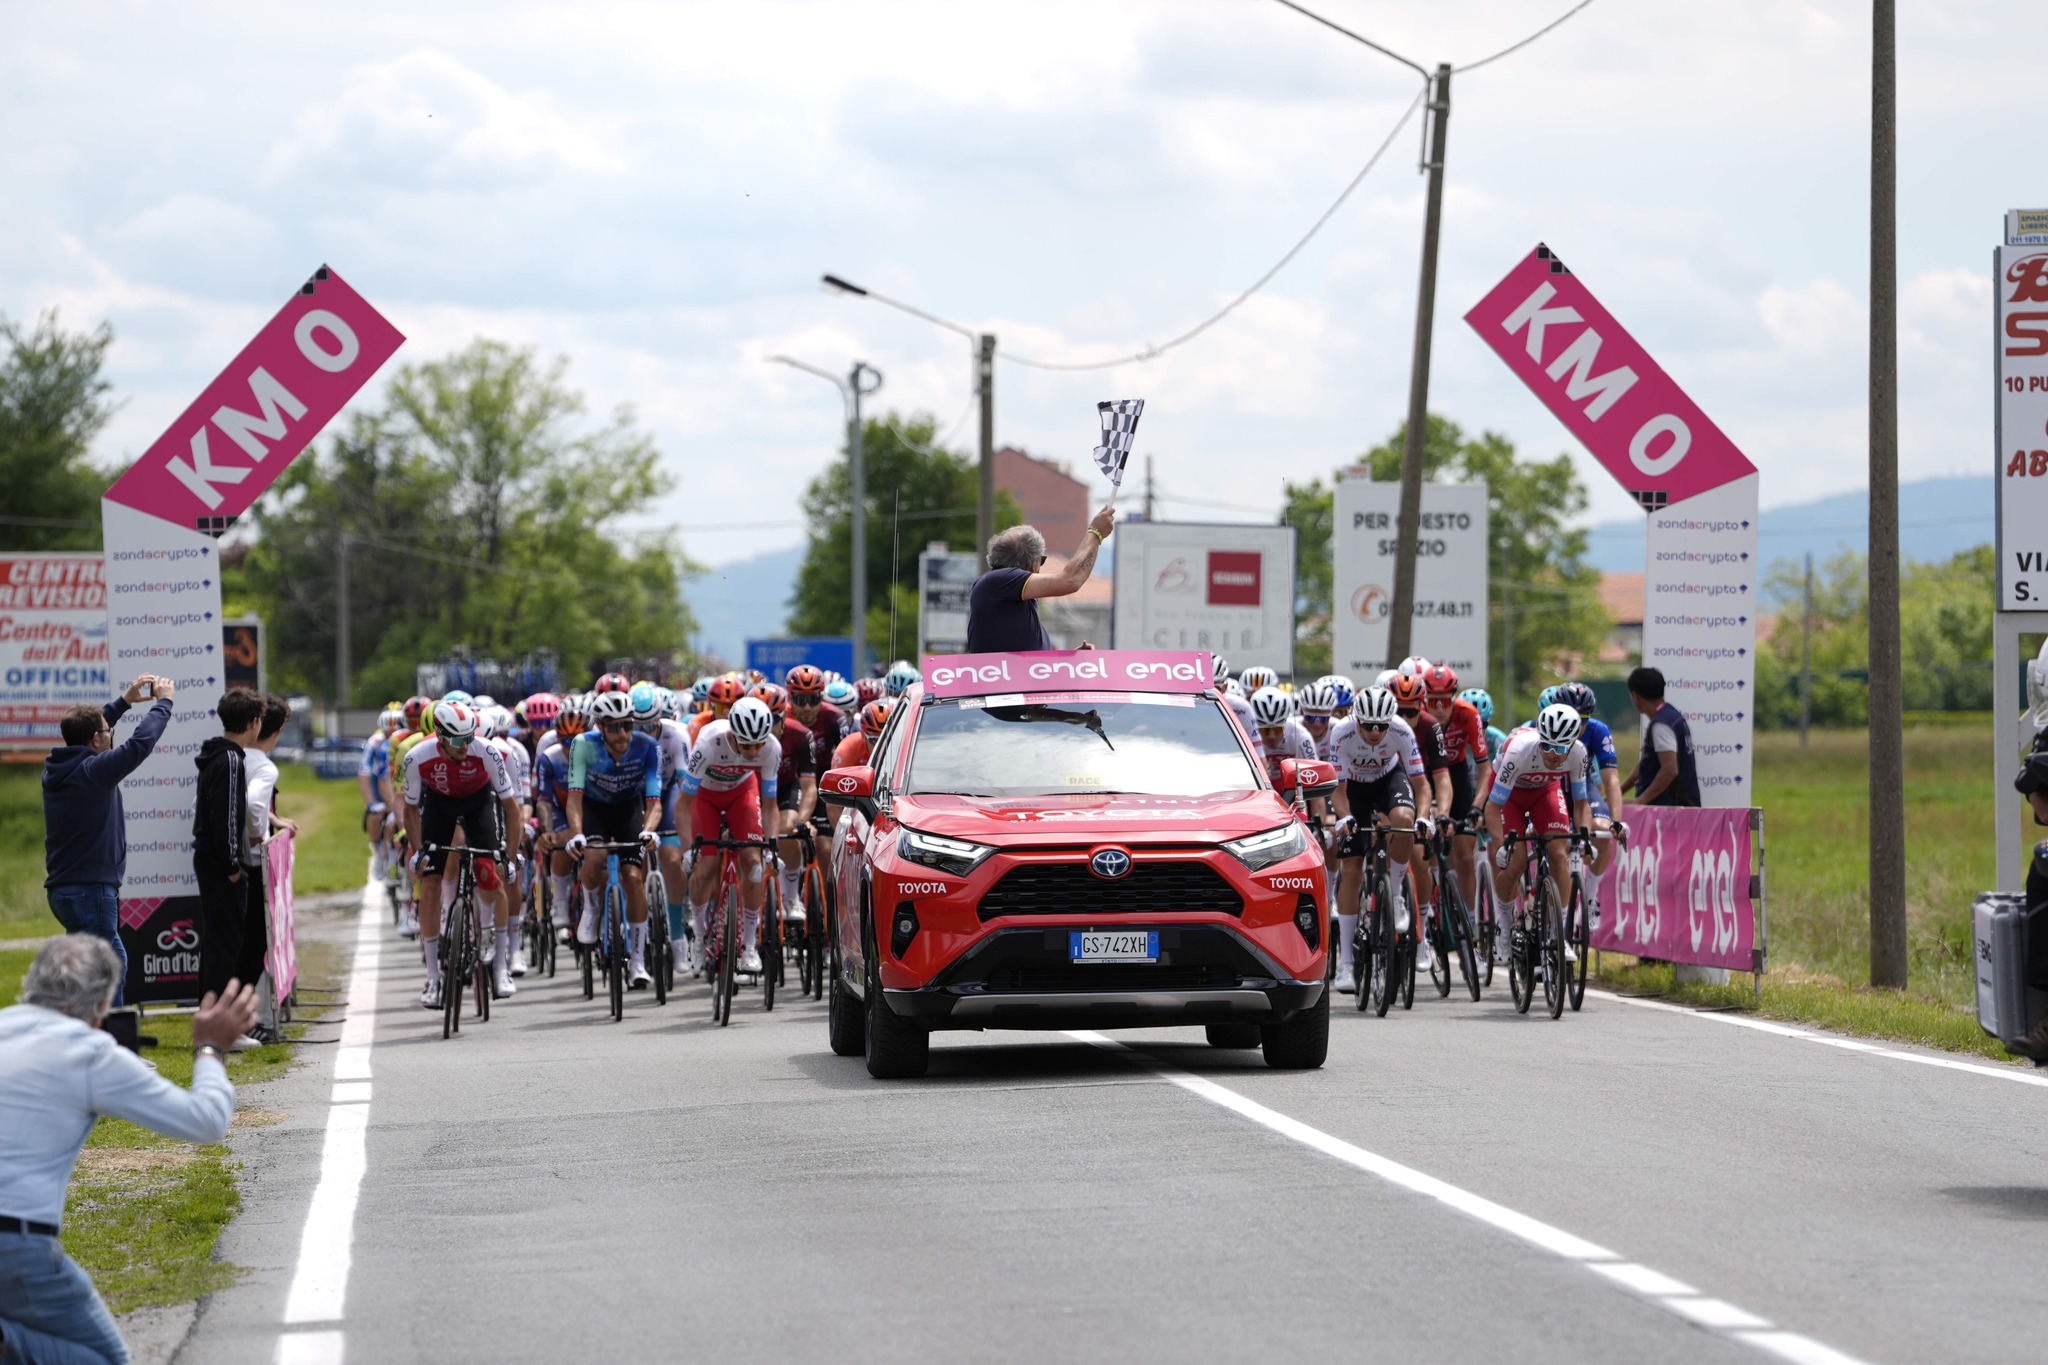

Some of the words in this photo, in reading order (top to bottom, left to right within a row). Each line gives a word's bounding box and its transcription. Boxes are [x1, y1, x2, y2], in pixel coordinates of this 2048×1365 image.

[1500, 280, 1640, 423] KM
[2005, 377, 2024, 392] 10
[165, 366, 308, 511] KM
[1353, 512, 1390, 530] PER
[1395, 512, 1471, 530] ESTO
[1657, 519, 1739, 532] zondacrypto
[113, 547, 198, 561] zondacrypto
[1377, 540, 1447, 557] SPZIO
[1656, 551, 1738, 564] zondacrypto
[2016, 552, 2048, 572] VI
[114, 581, 200, 594] zondacrypto
[1655, 583, 1737, 596] zondacrypto
[2015, 581, 2039, 601] S.
[116, 613, 202, 627] zondacrypto
[1654, 615, 1736, 628] zondacrypto
[0, 616, 73, 641] Centro
[22, 637, 109, 662] dell'Aut
[117, 645, 203, 659] zondacrypto
[1654, 647, 1735, 660] zondacrypto
[7, 667, 107, 687] OFFICIN
[931, 660, 1011, 686] enel
[1028, 657, 1108, 681] enel
[1126, 658, 1206, 682] enel
[1666, 679, 1734, 692] ndacrypto
[1432, 722, 1447, 756] INEOS
[1500, 762, 1515, 784] solo
[123, 777, 198, 789] zondacrypt
[1069, 777, 1101, 785] RACE
[124, 808, 196, 821] zondacryp
[1007, 809, 1203, 820] TOYOTA
[897, 882, 947, 894] TOYOTA
[1269, 877, 1314, 889] TOYOTA
[1614, 820, 1663, 946] enel
[1688, 821, 1739, 956] enel
[143, 954, 170, 974] Giro
